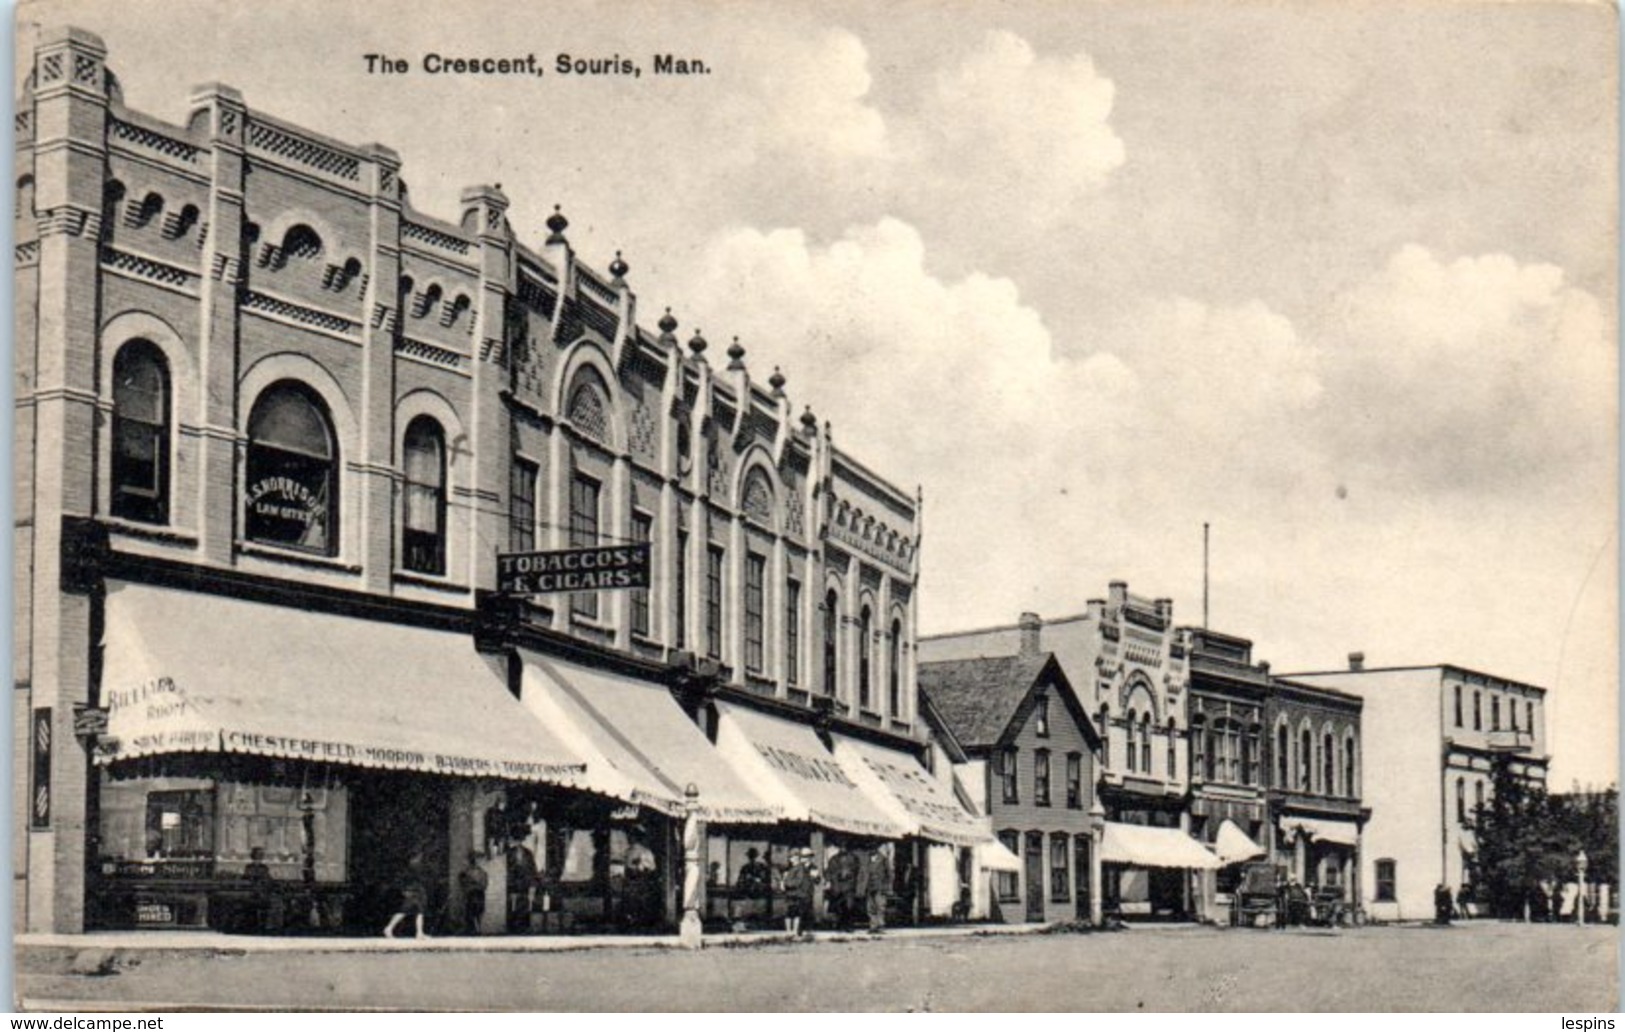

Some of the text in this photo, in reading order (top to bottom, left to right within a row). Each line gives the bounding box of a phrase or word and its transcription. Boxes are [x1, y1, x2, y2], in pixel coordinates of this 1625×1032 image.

[502, 550, 629, 574] TOBACCOS
[538, 569, 631, 591] CIGARS
[229, 731, 356, 758] CHESTERFIELD
